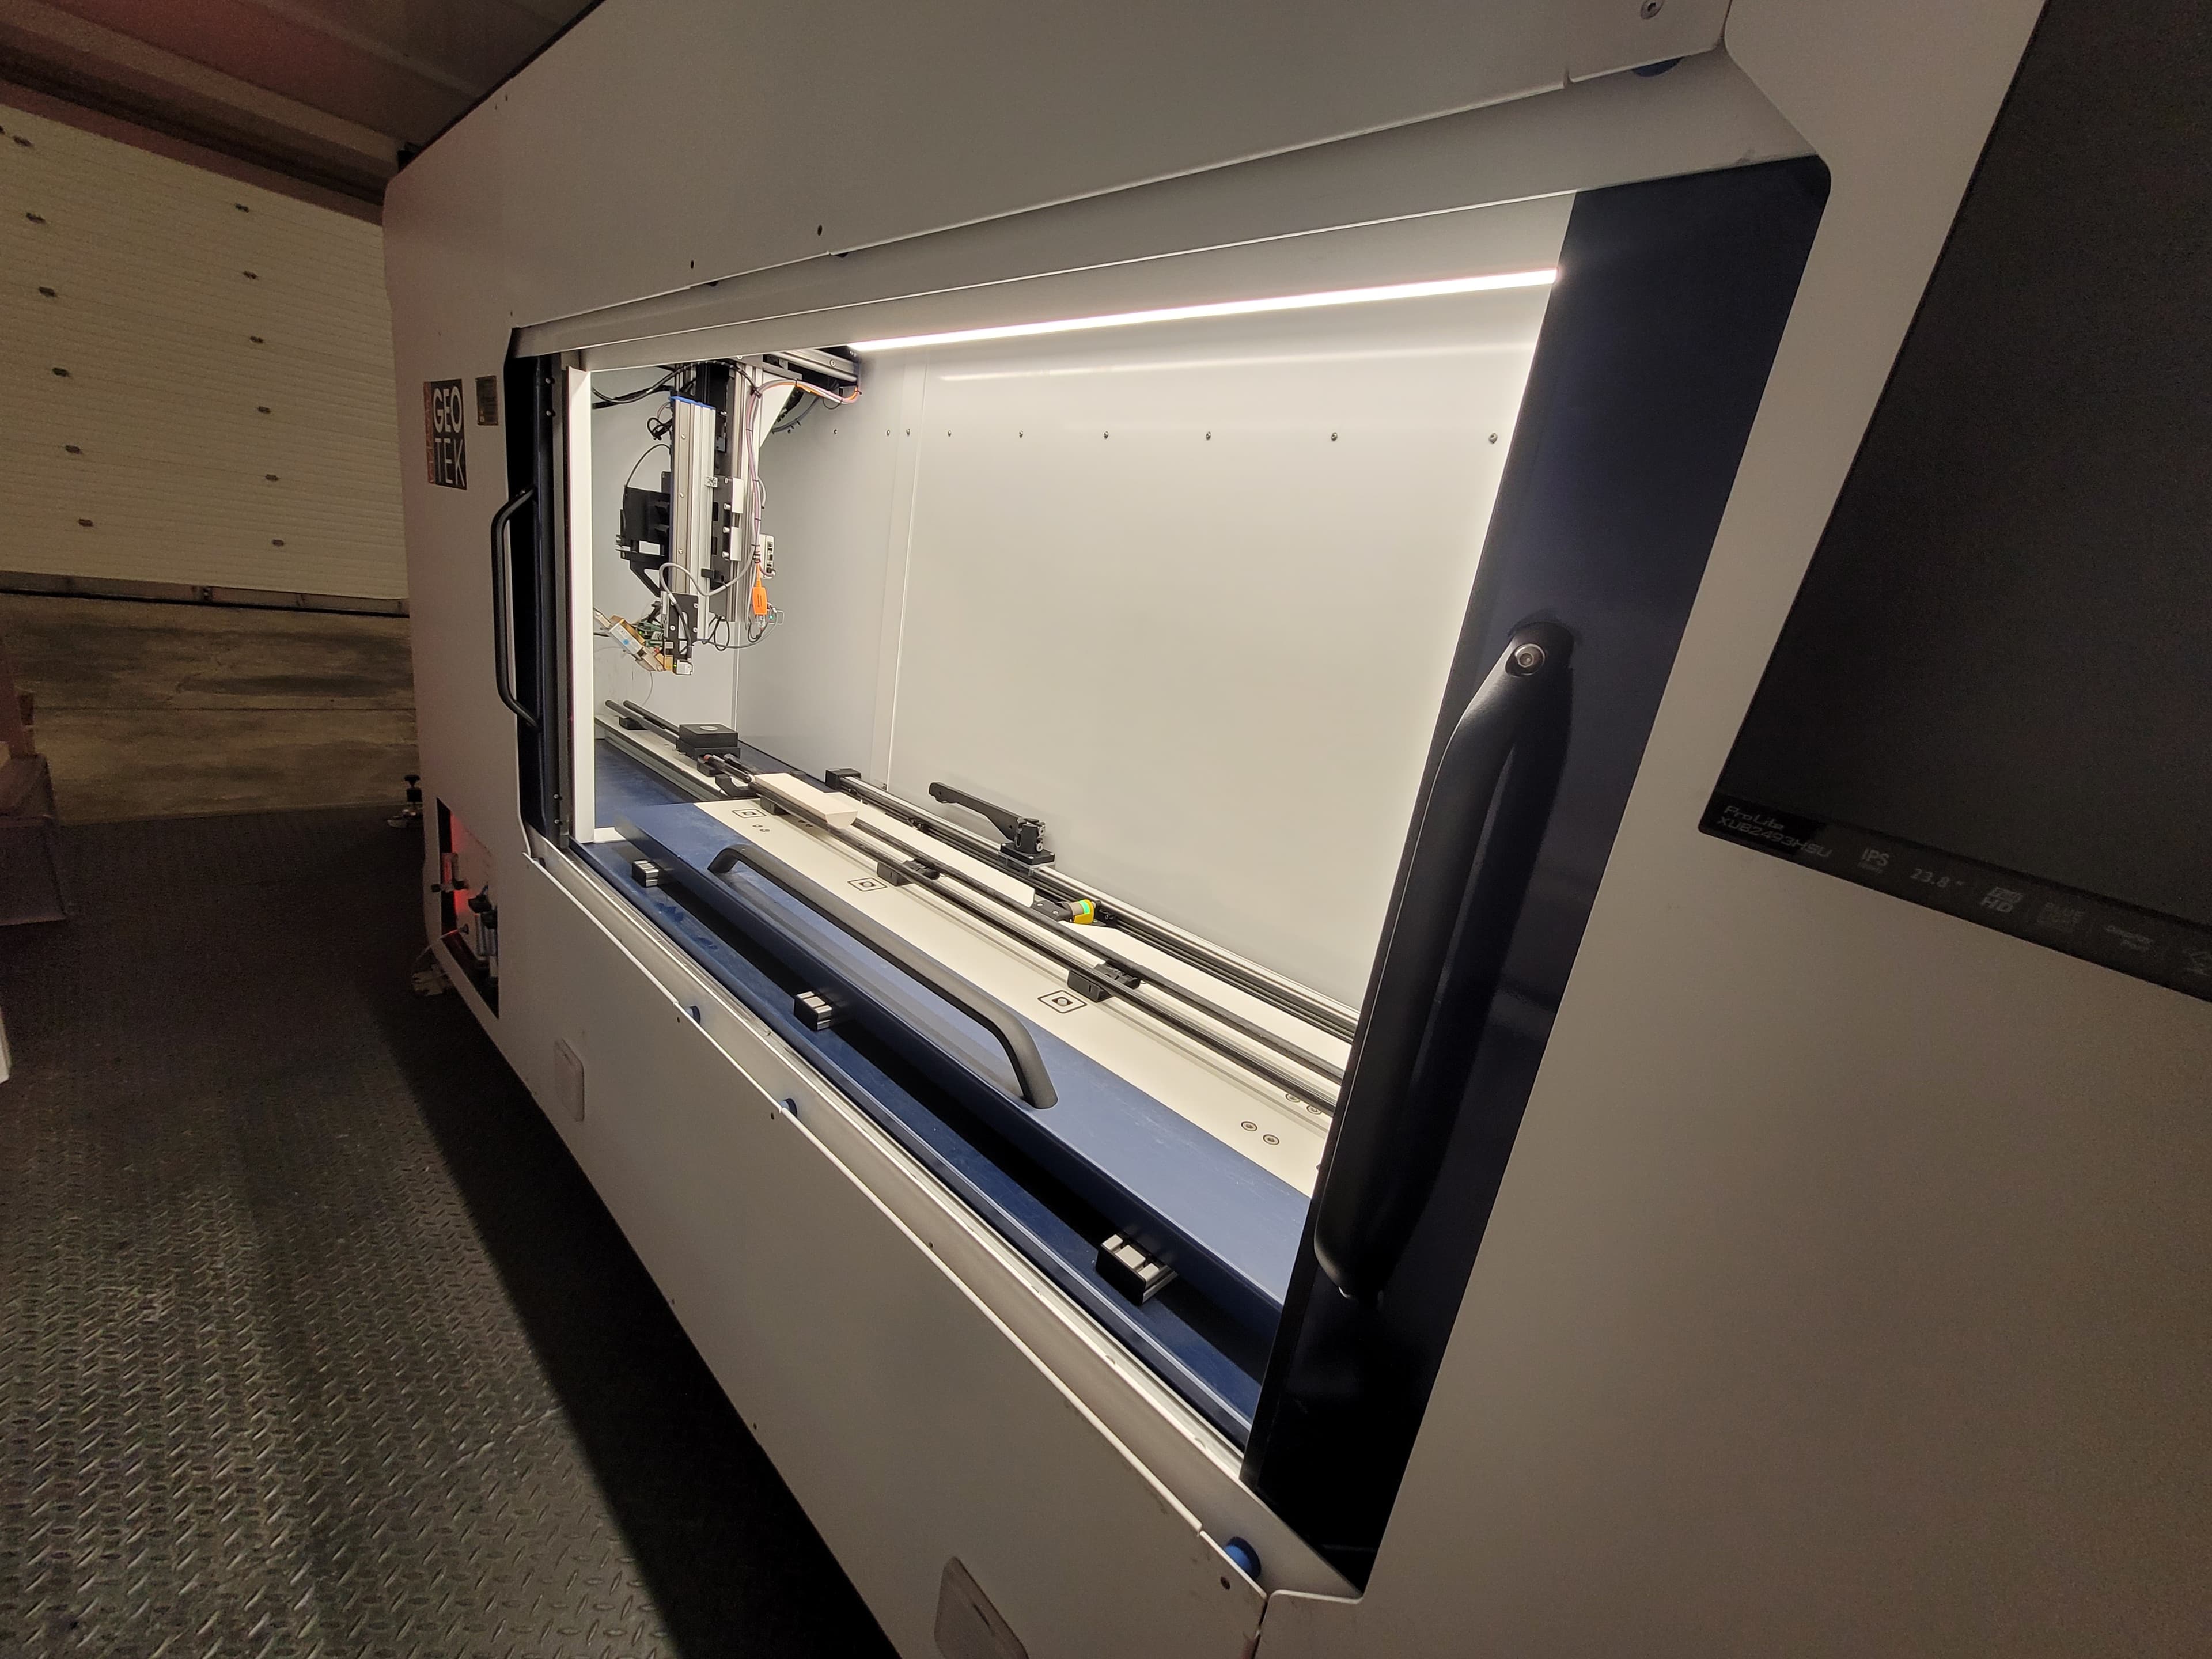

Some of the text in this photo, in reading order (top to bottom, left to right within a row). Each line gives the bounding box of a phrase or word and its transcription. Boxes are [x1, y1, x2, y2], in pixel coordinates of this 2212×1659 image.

[433, 386, 462, 433] GEO
[434, 438, 465, 487] TEK
[1724, 805, 1786, 831] ProLite
[1861, 847, 1890, 868] IPS
